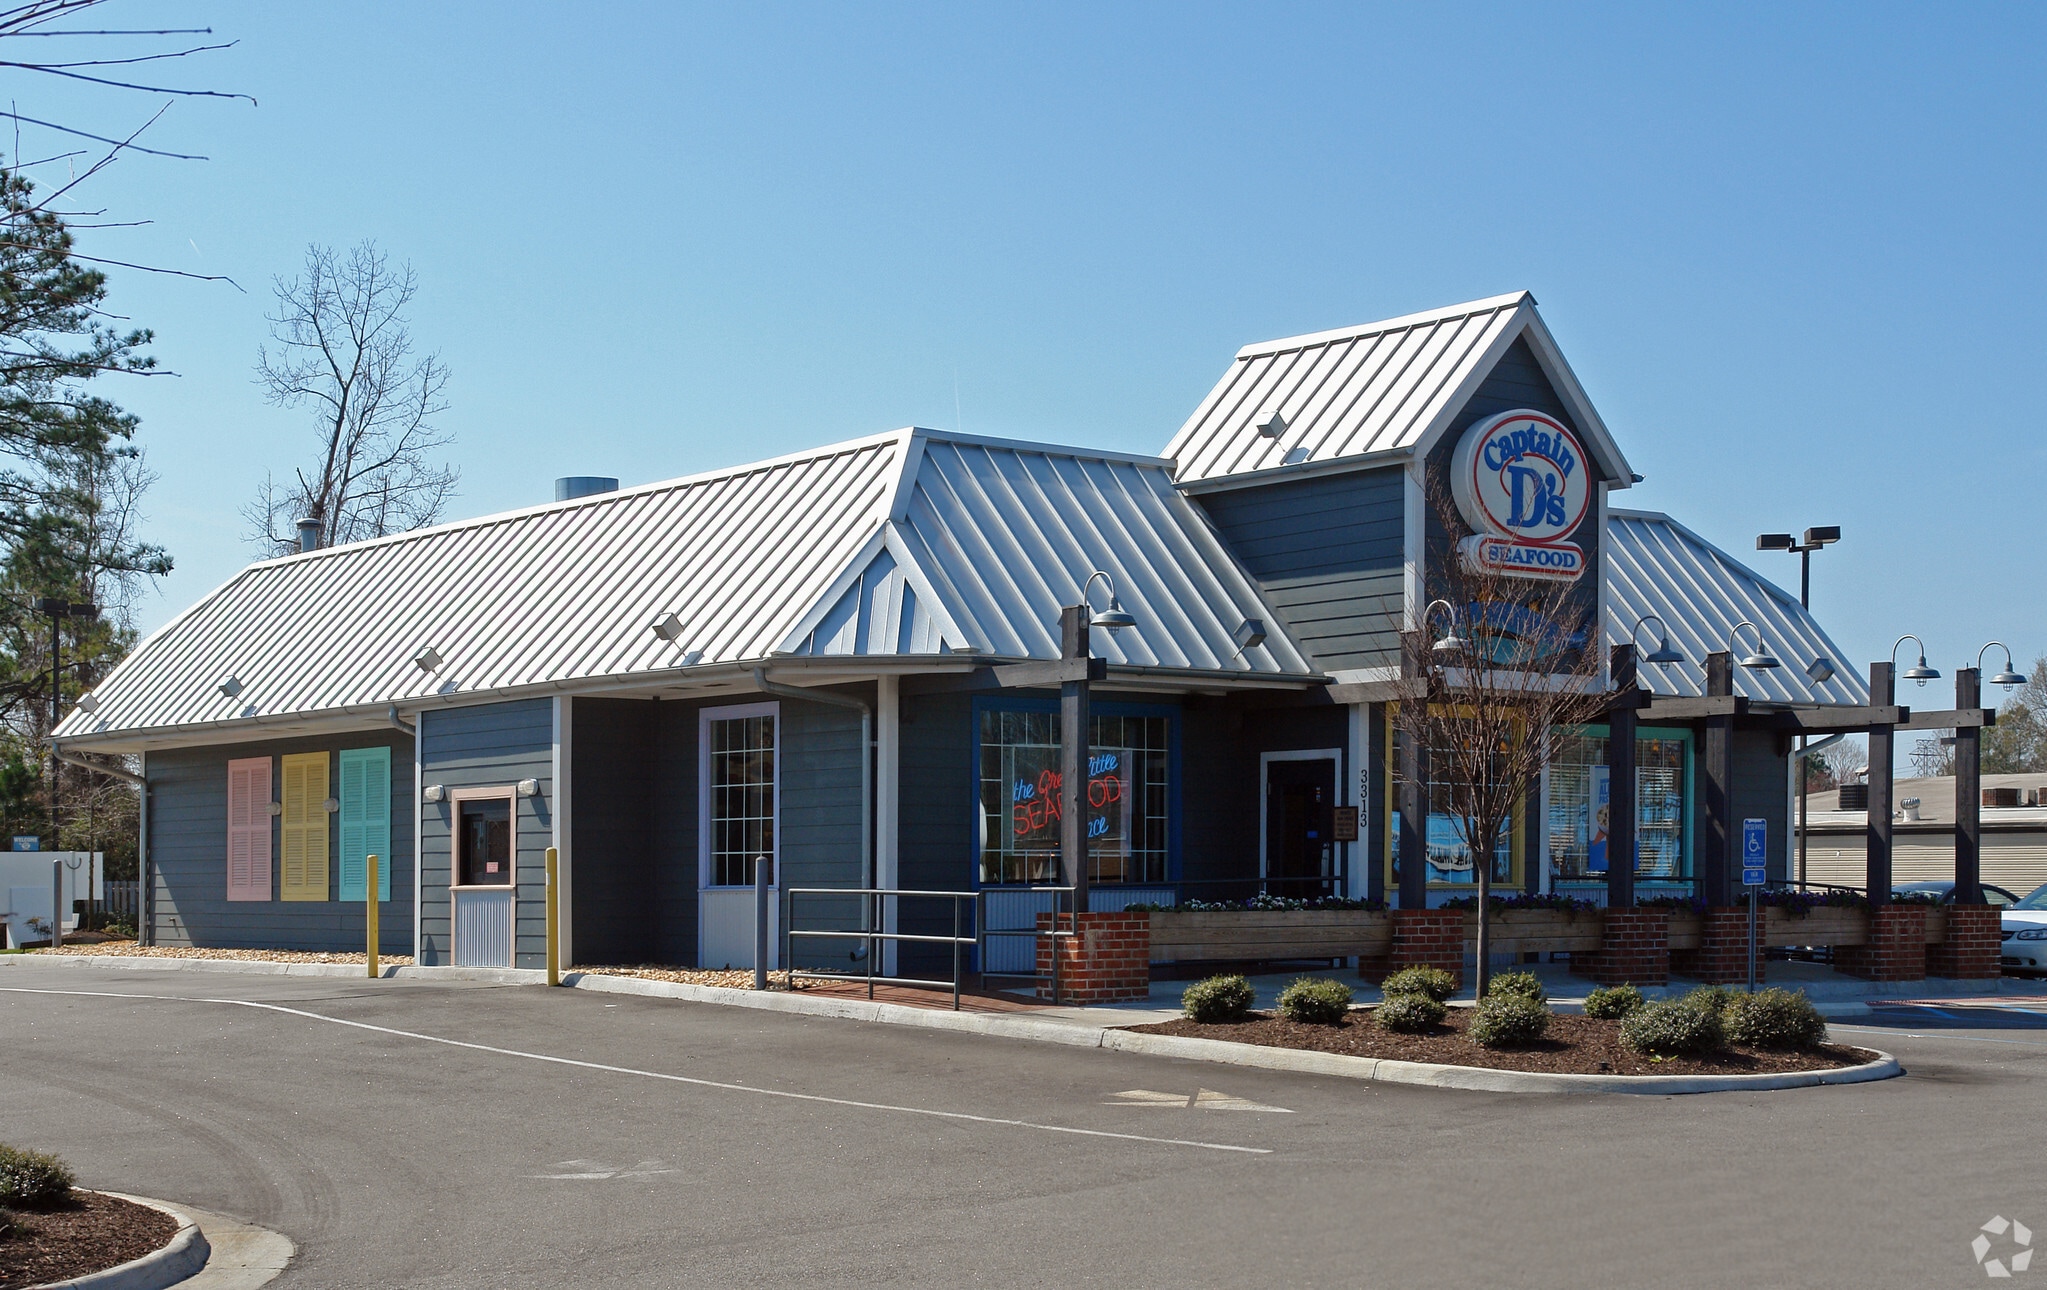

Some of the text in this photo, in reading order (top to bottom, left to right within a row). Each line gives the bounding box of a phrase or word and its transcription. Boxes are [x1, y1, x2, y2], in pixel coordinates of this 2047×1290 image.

[1484, 423, 1576, 478] Captain
[1506, 465, 1566, 528] D's
[1488, 545, 1576, 568] SEAFOOD
[1013, 753, 1119, 801] the Gre ittle
[1013, 775, 1121, 834] SEAOD
[1360, 769, 1368, 828] 3313
